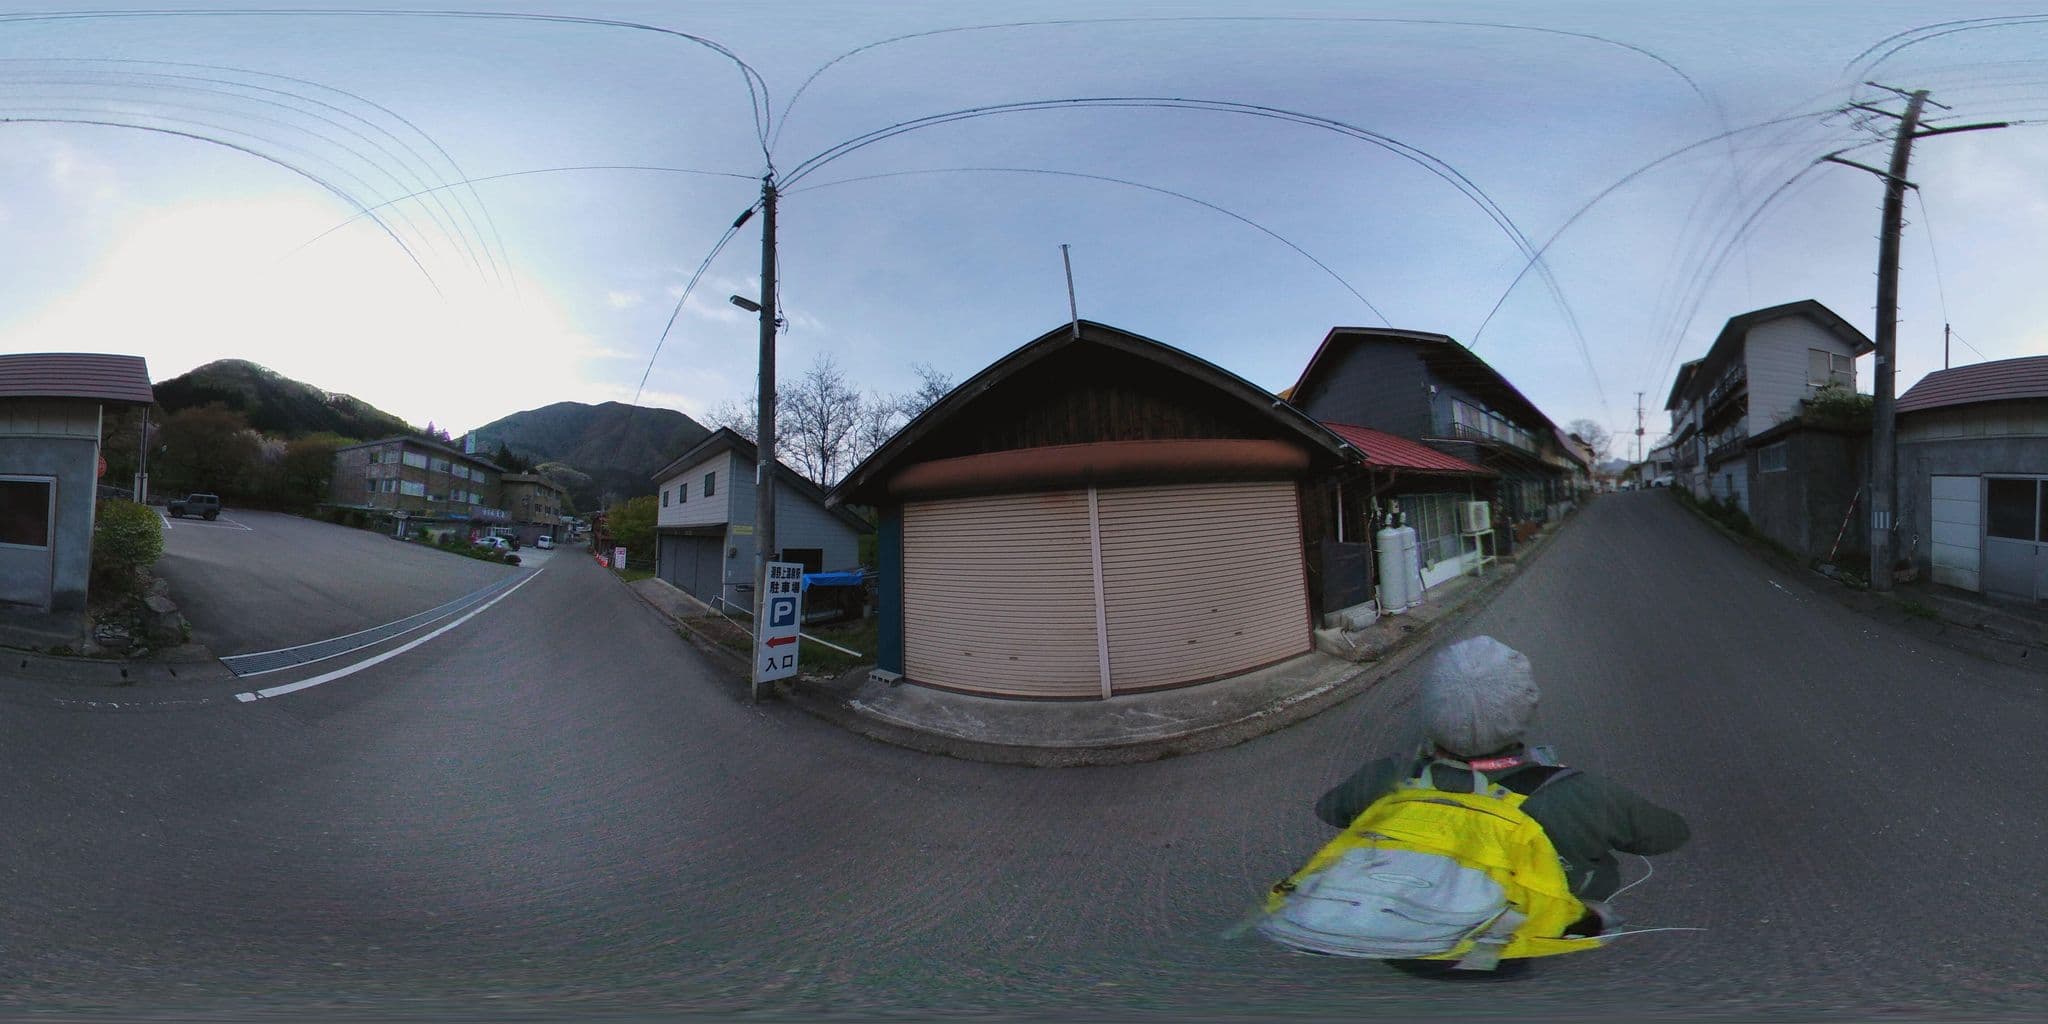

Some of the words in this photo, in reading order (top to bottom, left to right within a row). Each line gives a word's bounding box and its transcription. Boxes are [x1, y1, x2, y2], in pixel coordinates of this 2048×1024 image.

[770, 581, 800, 594] 駐車場
[773, 601, 793, 624] P
[765, 655, 793, 672] 入口
